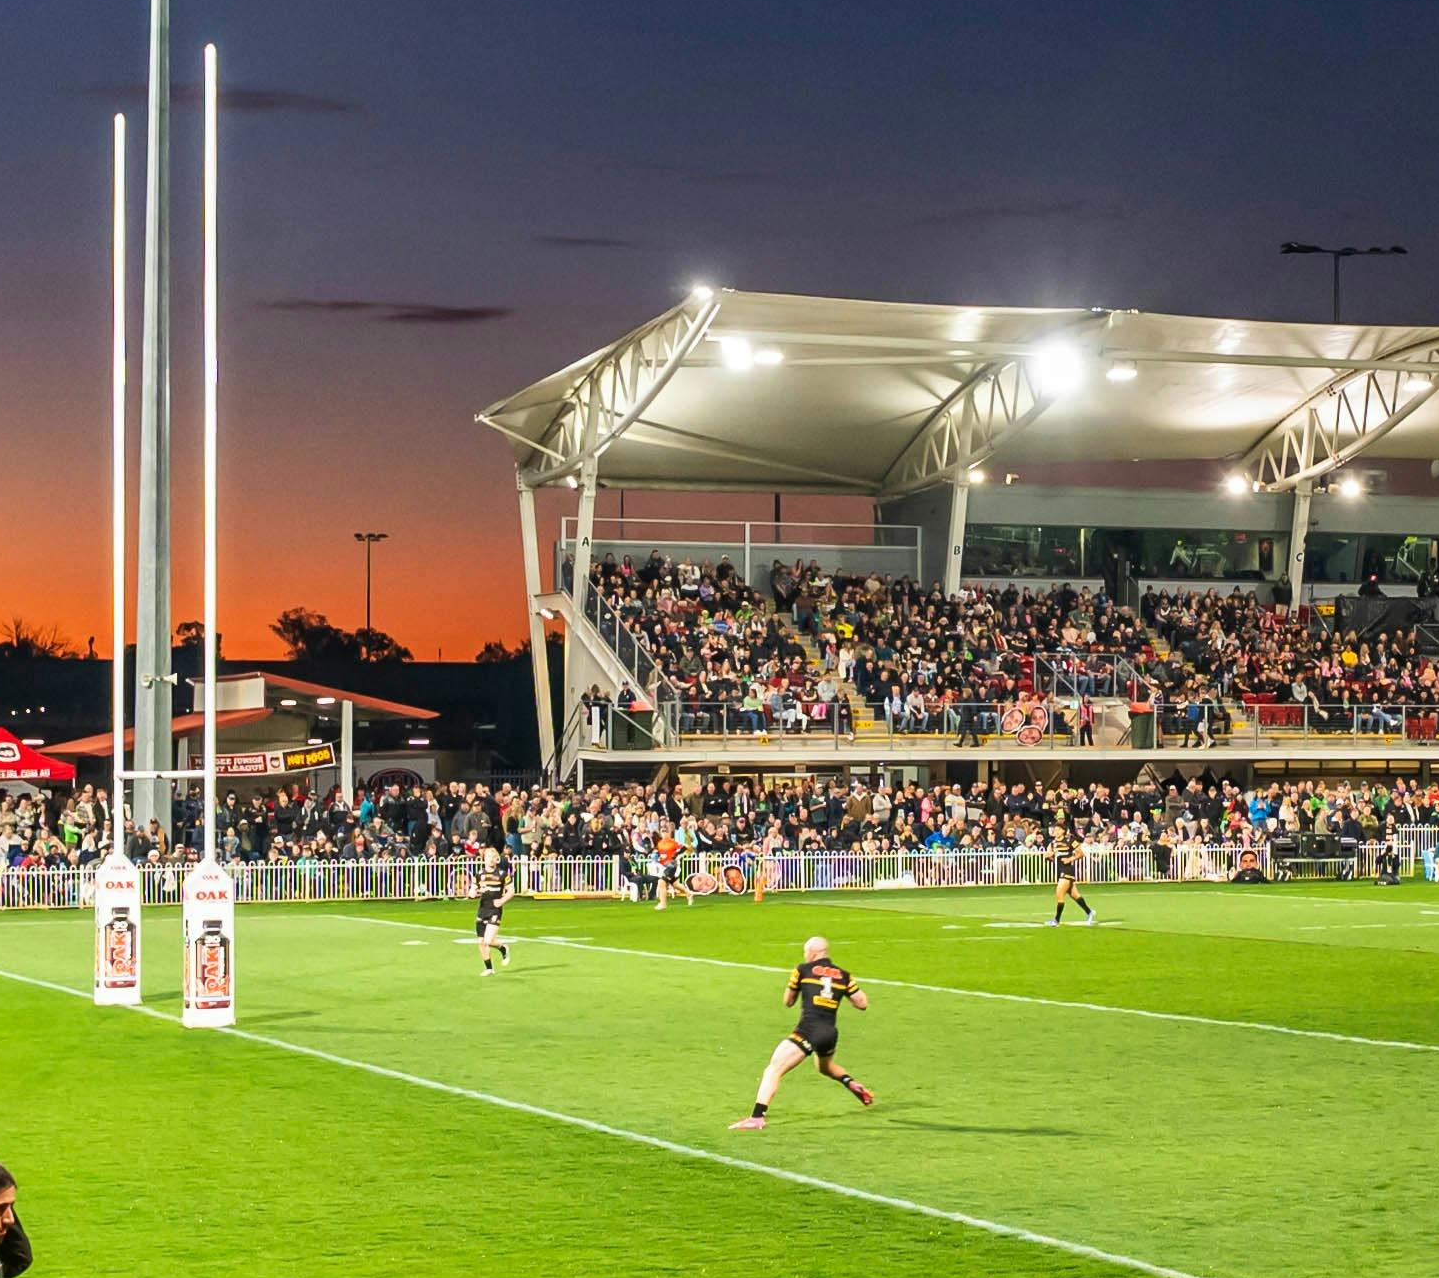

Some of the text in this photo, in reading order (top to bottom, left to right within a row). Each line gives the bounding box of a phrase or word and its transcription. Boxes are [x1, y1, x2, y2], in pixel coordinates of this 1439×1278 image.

[582, 536, 589, 547] A
[953, 545, 961, 555] B
[106, 881, 134, 889] OAK
[196, 891, 228, 901] OAK
[819, 977, 833, 999] 1
